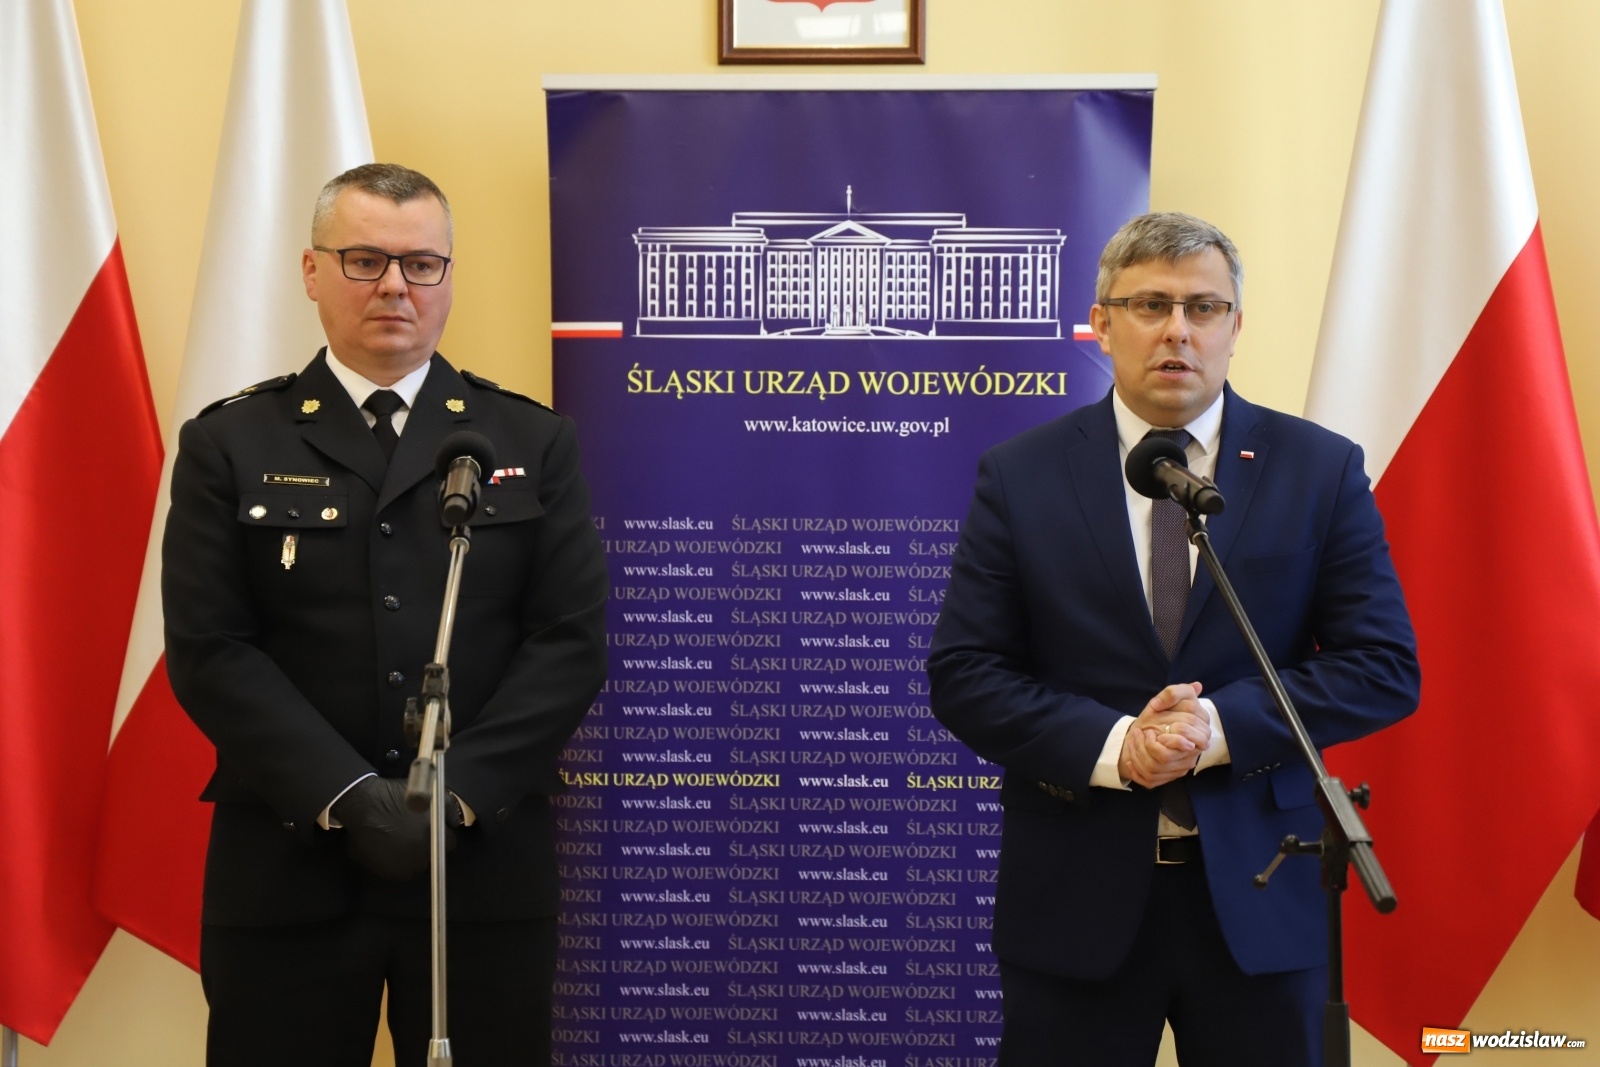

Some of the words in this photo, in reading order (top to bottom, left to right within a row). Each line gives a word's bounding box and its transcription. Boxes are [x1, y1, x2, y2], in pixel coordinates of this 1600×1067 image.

[627, 363, 735, 399] ŚLĄSKI
[744, 370, 850, 400] URZĄD
[858, 365, 1068, 396] WOJEWÓDZKI
[744, 416, 950, 437] www.katowice.uw.gov.pl
[624, 517, 713, 530] www.slask.eu
[732, 515, 788, 534] ŚLĄSKI
[792, 518, 847, 534] URZĄD
[851, 516, 959, 532] WOJEWÓDZKI
[615, 540, 670, 556] URZĄD
[674, 538, 782, 554] WOJEWÓDZKI
[801, 542, 890, 555] www.slask.eu
[909, 540, 958, 558] ŚLĄSK
[624, 564, 713, 576] www.slask.eu
[732, 562, 787, 580] ŚLĄSKI
[792, 565, 847, 581] URZĄD
[851, 563, 952, 578] WOJEWÓDZK
[615, 587, 670, 603] URZĄD
[674, 585, 781, 600] WOJEWÓDZKI
[801, 588, 890, 601] www.slask.eu
[908, 586, 946, 605] ŚLĄS
[623, 610, 712, 623] www.slask.eu
[731, 608, 787, 627] ŚLĄSKI
[792, 612, 846, 627] URZĄD
[850, 609, 940, 625] WOJEWÓDZ
[614, 634, 669, 649] URZĄD
[674, 631, 781, 647] WOJEWÓDZKI
[800, 635, 890, 648] www.slask.eu
[623, 657, 712, 670] www.slask.eu
[731, 655, 787, 673] ŚLĄSKI
[791, 658, 846, 674] URZĄD
[850, 656, 927, 671] WOJEWÓD
[614, 680, 669, 696] URZĄD
[673, 678, 780, 694] WOJEWÓDZKI
[800, 682, 889, 695] www.slask.eu
[622, 704, 712, 716] www.slask.eu
[730, 702, 786, 720] ŚLĄSKI
[791, 705, 845, 721] URZĄD
[850, 703, 934, 718] WOJEWÓD
[572, 726, 609, 742] ĄSKI
[613, 727, 668, 743] URZĄD
[673, 725, 780, 740] WOJEWÓDZKI
[799, 728, 889, 741] www.slask.eu
[907, 726, 961, 744] ŚLĄSK
[622, 750, 711, 763] www.slask.eu
[730, 748, 786, 767] ŚLĄSKI
[791, 752, 845, 767] URZĄD
[849, 749, 957, 765] WOJEWÓDZKI
[613, 774, 668, 789] URZĄD
[672, 771, 779, 787] WOJEWÓDZKI
[799, 775, 888, 788] www.slask.eu
[907, 773, 963, 791] ŚLĄSKI
[968, 777, 1002, 789] URZ
[622, 797, 711, 810] www.slask.eu
[730, 795, 785, 813] ŚLĄSKI
[790, 798, 845, 814] URZĄD
[849, 796, 957, 812] WOJEWÓDZKI
[556, 816, 608, 835] ŚLĄSKI
[612, 820, 667, 836] URZĄD
[672, 818, 779, 834] WOJEWÓDZKI
[799, 822, 888, 834] www.slask.eu
[907, 819, 962, 838] ŚLĄSKI
[968, 823, 1002, 836] URZ
[621, 844, 710, 856] www.slask.eu
[729, 842, 785, 860] ŚLĄSKI
[790, 845, 844, 861] URZĄD
[848, 843, 956, 858] WOJEWÓDZKI
[612, 867, 667, 883] URZĄD
[671, 865, 779, 880] WOJEWÓDZKI
[798, 868, 888, 881] www.slask.eu
[906, 866, 962, 884] ŚLĄSKI
[967, 870, 999, 883] URZ
[621, 890, 710, 903] www.slask.eu
[729, 888, 785, 907] ŚLĄSKI
[789, 892, 844, 907] URZĄD
[848, 889, 956, 905] WOJEWÓDZKI
[612, 914, 667, 929] URZĄD
[671, 911, 778, 927] WOJEWÓDZKI
[798, 915, 887, 928] www.slask.eu
[906, 913, 962, 931] ŚLĄSKI
[967, 917, 994, 929] URZ
[620, 937, 710, 950] www.slask.eu
[728, 935, 784, 953] ŚLĄSKI
[789, 938, 844, 954] URZĄD
[848, 936, 956, 952] WOJEWÓDZKI
[611, 960, 666, 976] URZĄD
[670, 958, 778, 974] WOJEWÓDZKI
[797, 962, 887, 974] www.slask.eu
[905, 959, 961, 978] ŚLĄSKI
[966, 963, 1000, 976] URZ
[620, 984, 709, 996] www.slask.eu
[728, 982, 784, 1000] ŚLĄSKI
[789, 985, 843, 1000] URZĄD
[847, 982, 955, 998] WOJEWÓDZKI
[611, 1007, 666, 1022] URZĄD
[670, 1004, 777, 1020] WOJEWÓDZKI
[797, 1008, 887, 1021] www.slask.eu
[905, 1006, 961, 1024] ŚLĄSKI
[966, 1010, 1003, 1022] URZ
[620, 1030, 709, 1043] www.slask.eu
[728, 1028, 783, 1047] ŚLĄSKI
[788, 1032, 843, 1047] URZĄD
[847, 1029, 955, 1045] WOJEWÓDZKI
[610, 1054, 665, 1067] URZĄD
[670, 1051, 777, 1067] WOJEWÓDZKI
[797, 1055, 886, 1067] www.slask.eu
[905, 1053, 961, 1067] ŚLĄSKI
[966, 1057, 998, 1067] URZ
